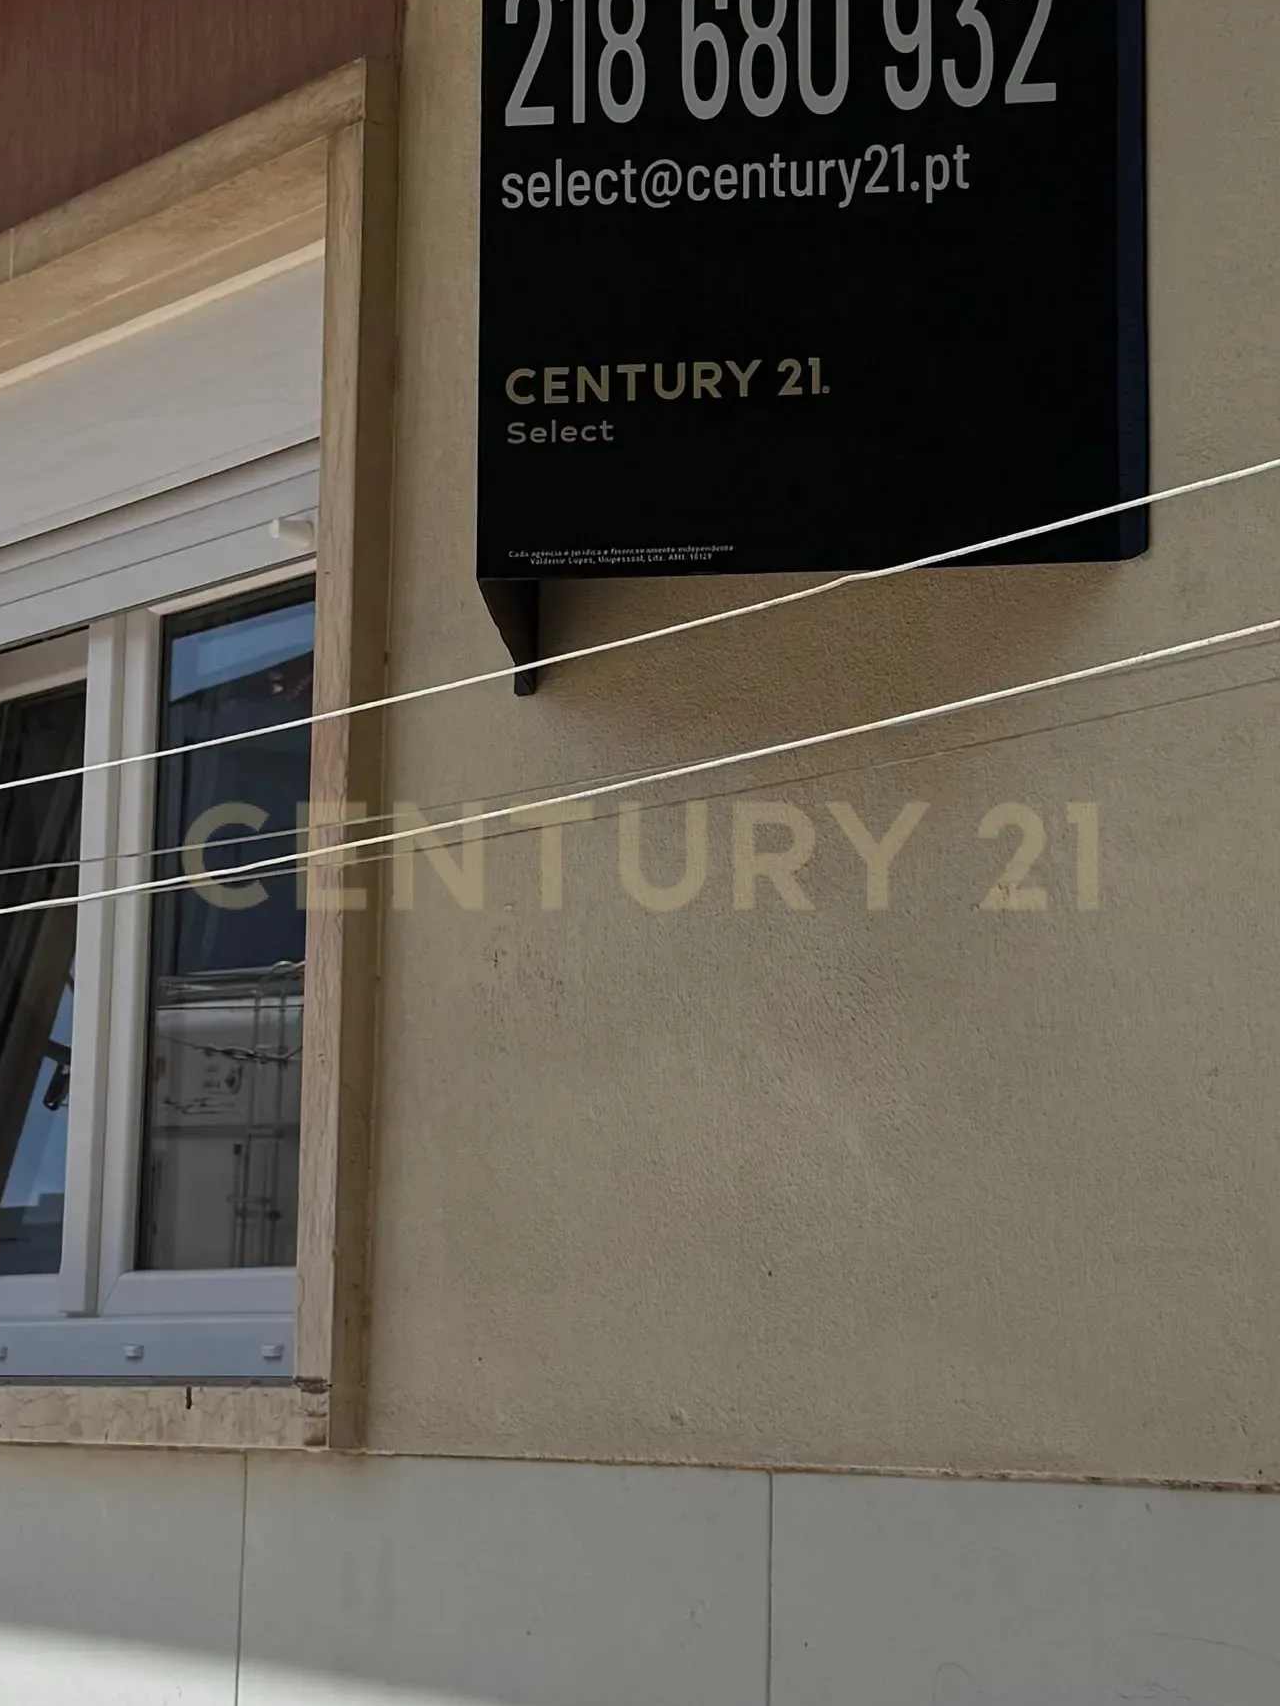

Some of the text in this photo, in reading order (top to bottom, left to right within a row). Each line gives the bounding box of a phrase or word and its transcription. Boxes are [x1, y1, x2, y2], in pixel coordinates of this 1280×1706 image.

[501, 143, 971, 209] select@century21.pt
[505, 359, 763, 405] CENTURY
[507, 419, 614, 444] Select
